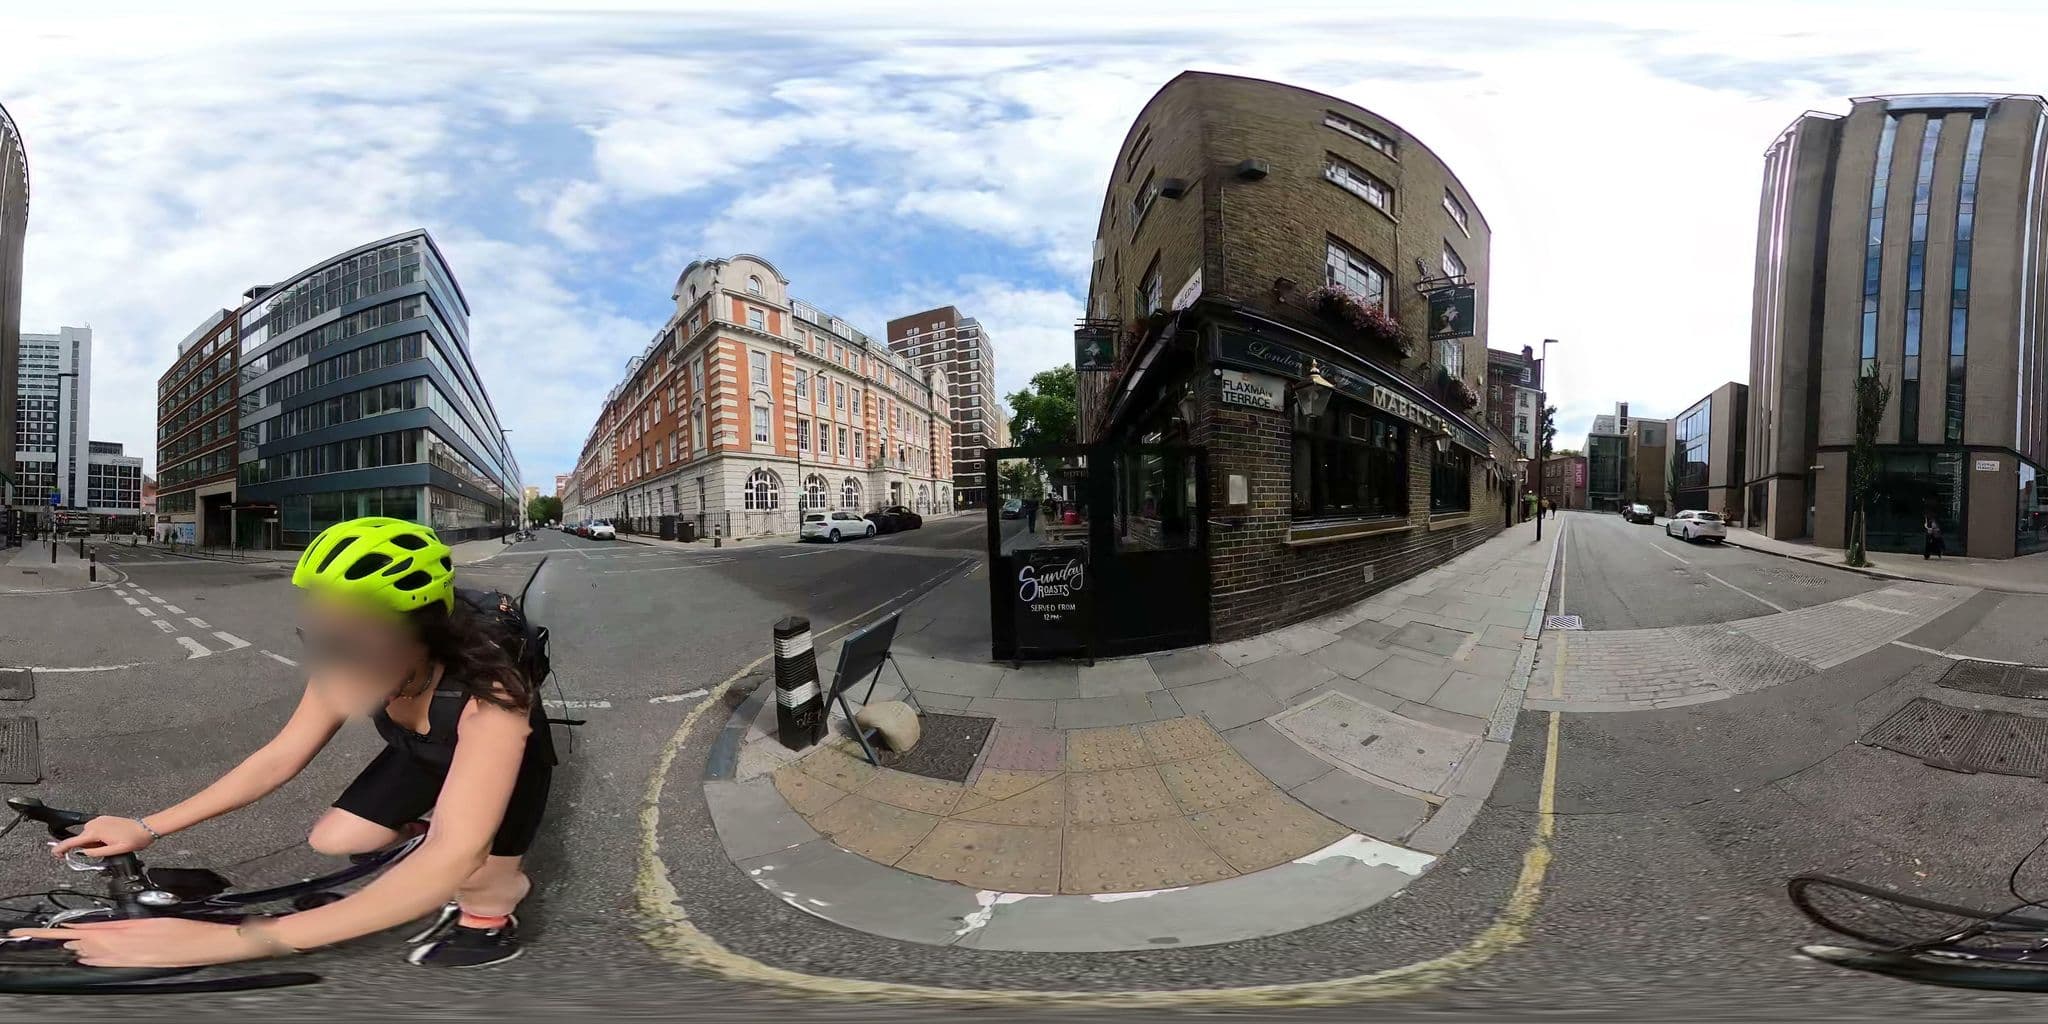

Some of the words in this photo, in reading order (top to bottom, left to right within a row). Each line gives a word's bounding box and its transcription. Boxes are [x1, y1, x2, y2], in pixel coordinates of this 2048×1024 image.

[1247, 341, 1302, 371] London
[1223, 391, 1271, 409] TERRACE
[1019, 558, 1084, 602] Sunday
[1038, 584, 1070, 598] ROASTS
[1031, 604, 1056, 612] SERVED
[1058, 603, 1076, 611] FROM
